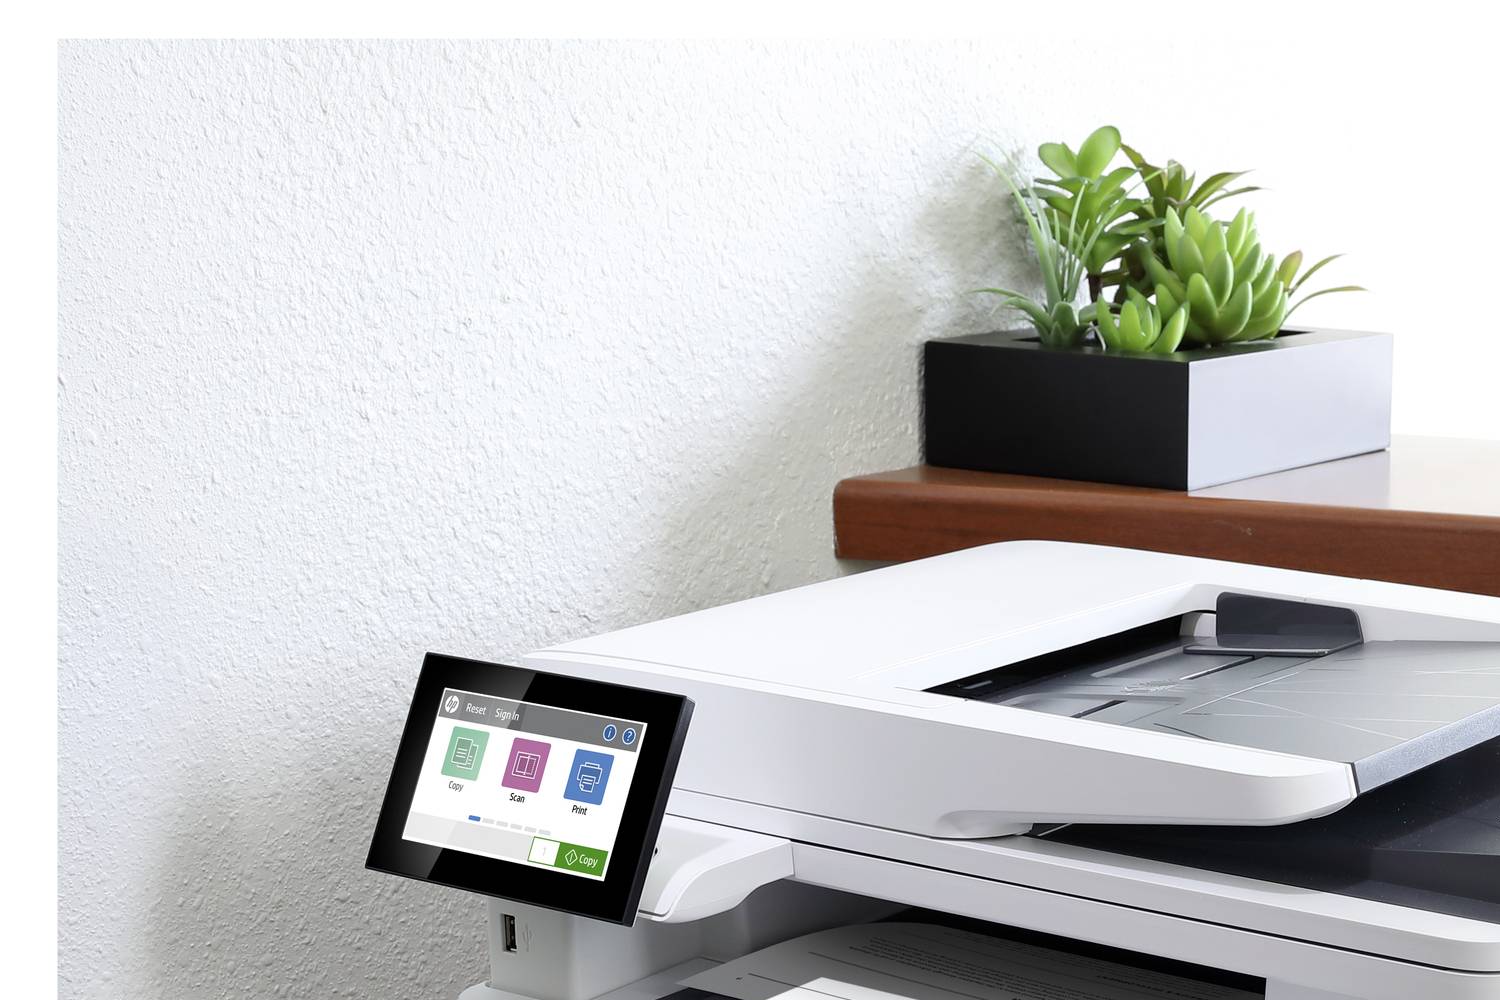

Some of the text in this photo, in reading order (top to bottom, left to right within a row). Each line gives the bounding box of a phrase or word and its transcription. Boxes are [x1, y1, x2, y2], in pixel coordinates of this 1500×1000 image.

[465, 702, 487, 716] Reset
[495, 707, 511, 722] Sign
[448, 780, 464, 793] Copy
[509, 792, 526, 803] Scan
[571, 804, 588, 816] Print
[579, 853, 598, 868] Copy
